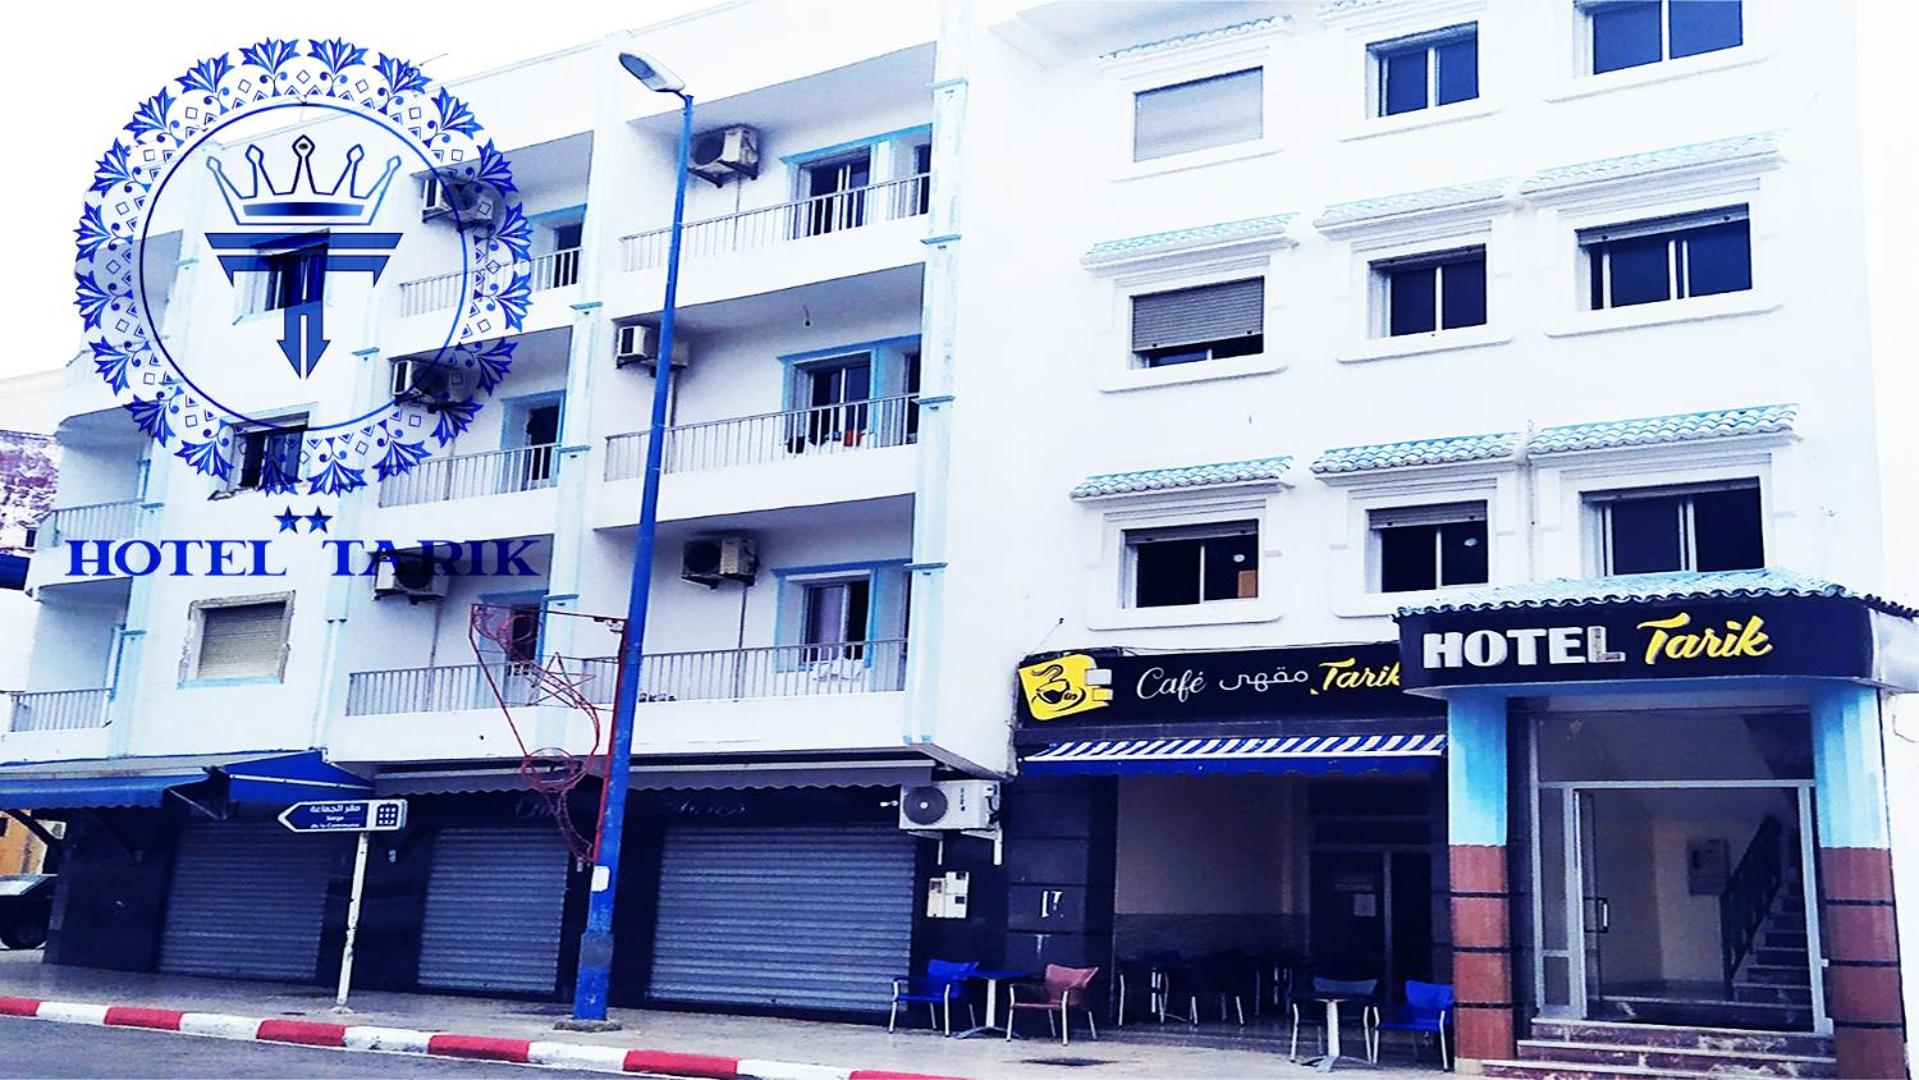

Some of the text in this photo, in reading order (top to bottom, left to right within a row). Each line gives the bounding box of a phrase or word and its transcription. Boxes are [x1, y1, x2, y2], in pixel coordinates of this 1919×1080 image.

[1423, 612, 1774, 669] HOTEL Tarik
[1136, 666, 1208, 703] Café
